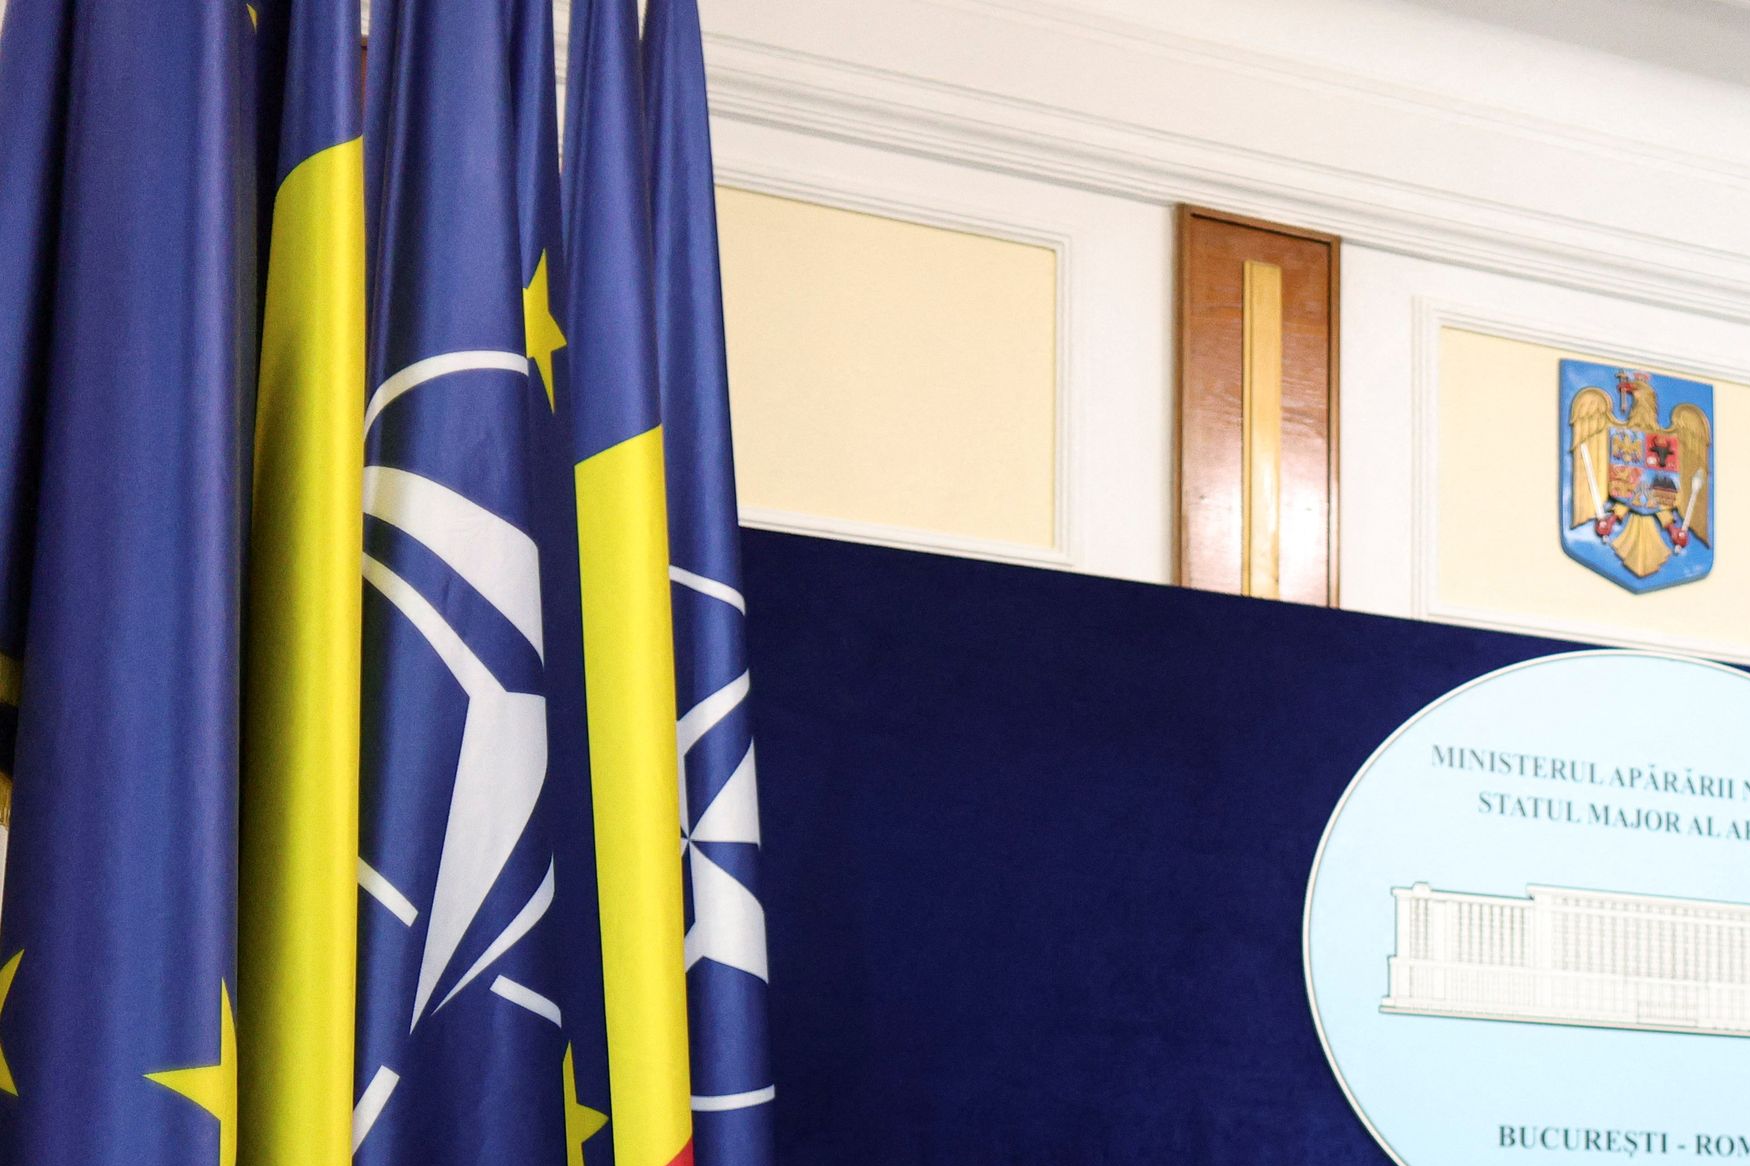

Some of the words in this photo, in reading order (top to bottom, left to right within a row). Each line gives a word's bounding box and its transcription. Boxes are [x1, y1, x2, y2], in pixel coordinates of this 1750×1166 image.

[1432, 744, 1603, 786] MINISTERUL
[1608, 763, 1734, 800] APĂRĂRII
[1478, 790, 1581, 823] STATUL
[1588, 802, 1681, 834] MAJOR
[1688, 815, 1720, 838] AL
